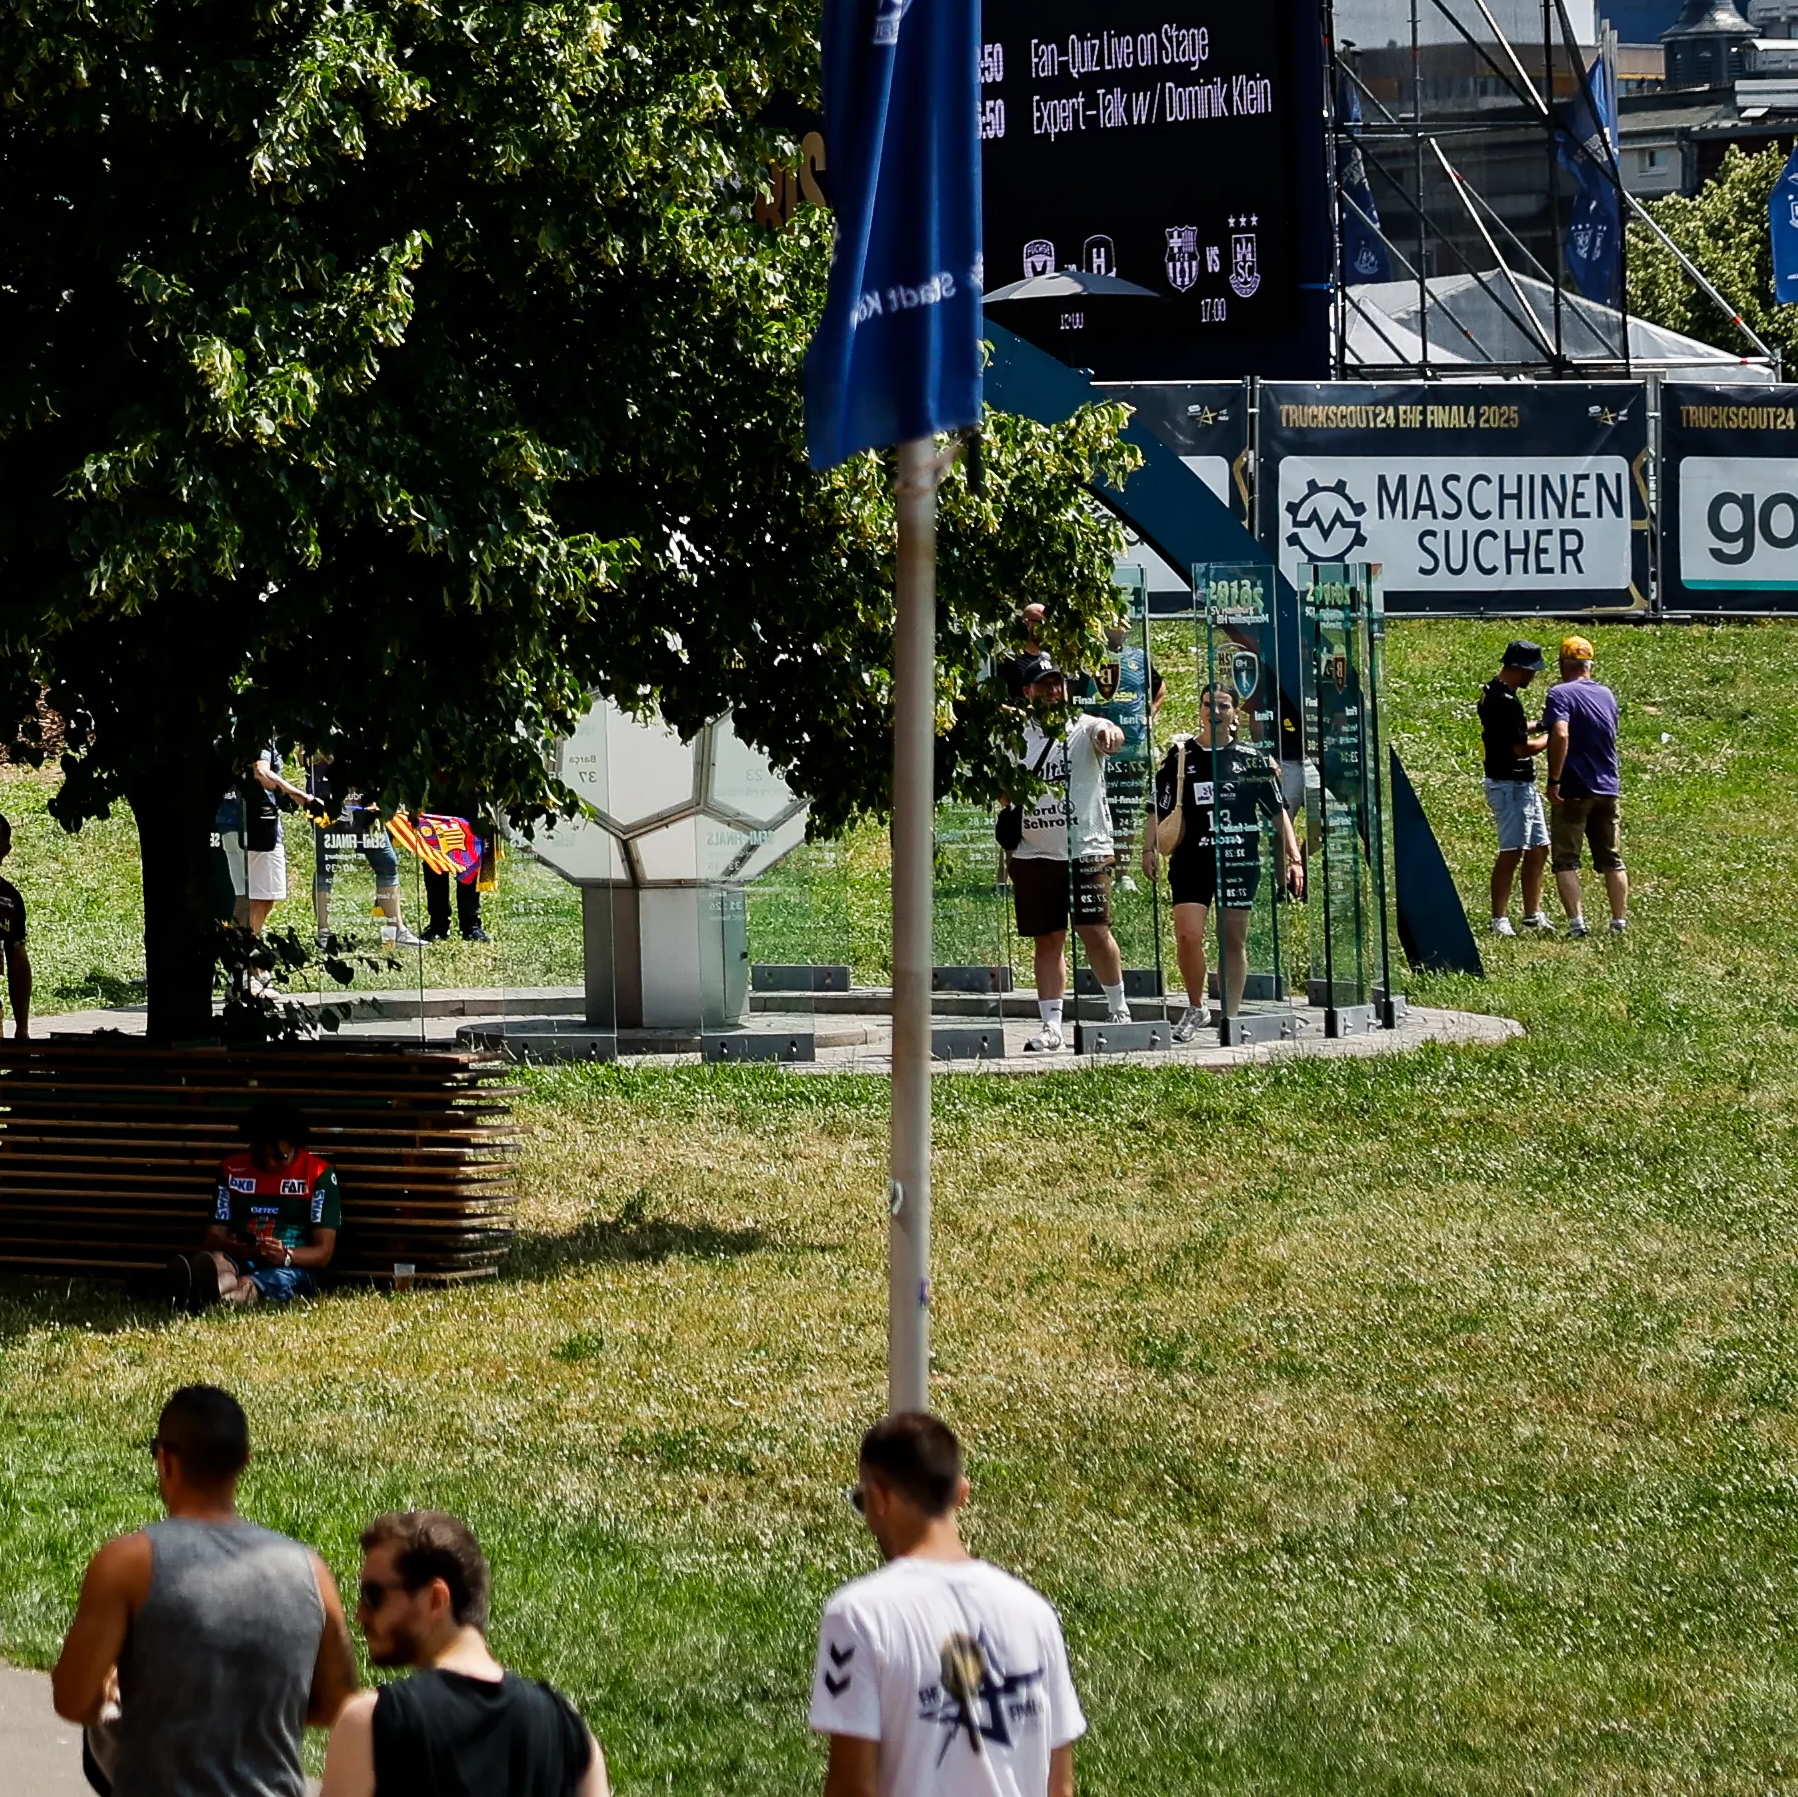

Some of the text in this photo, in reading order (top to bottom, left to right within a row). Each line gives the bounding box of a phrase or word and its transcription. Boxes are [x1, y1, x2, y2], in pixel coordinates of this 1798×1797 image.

[1103, 30, 1134, 70] Live
[1137, 31, 1158, 66] on
[1161, 23, 1209, 71] Stage
[1165, 75, 1229, 123] Dominik
[1232, 72, 1272, 116] Klein
[1237, 262, 1252, 282] SC
[1279, 404, 1519, 429] TRUCKSCOUT24 EHF FINAL4 2025
[1681, 405, 1796, 429] TRUCKSCOUT24
[1376, 472, 1624, 521] MASCHINEN
[1417, 528, 1586, 577] SUCHER
[1072, 695, 1096, 706] Final
